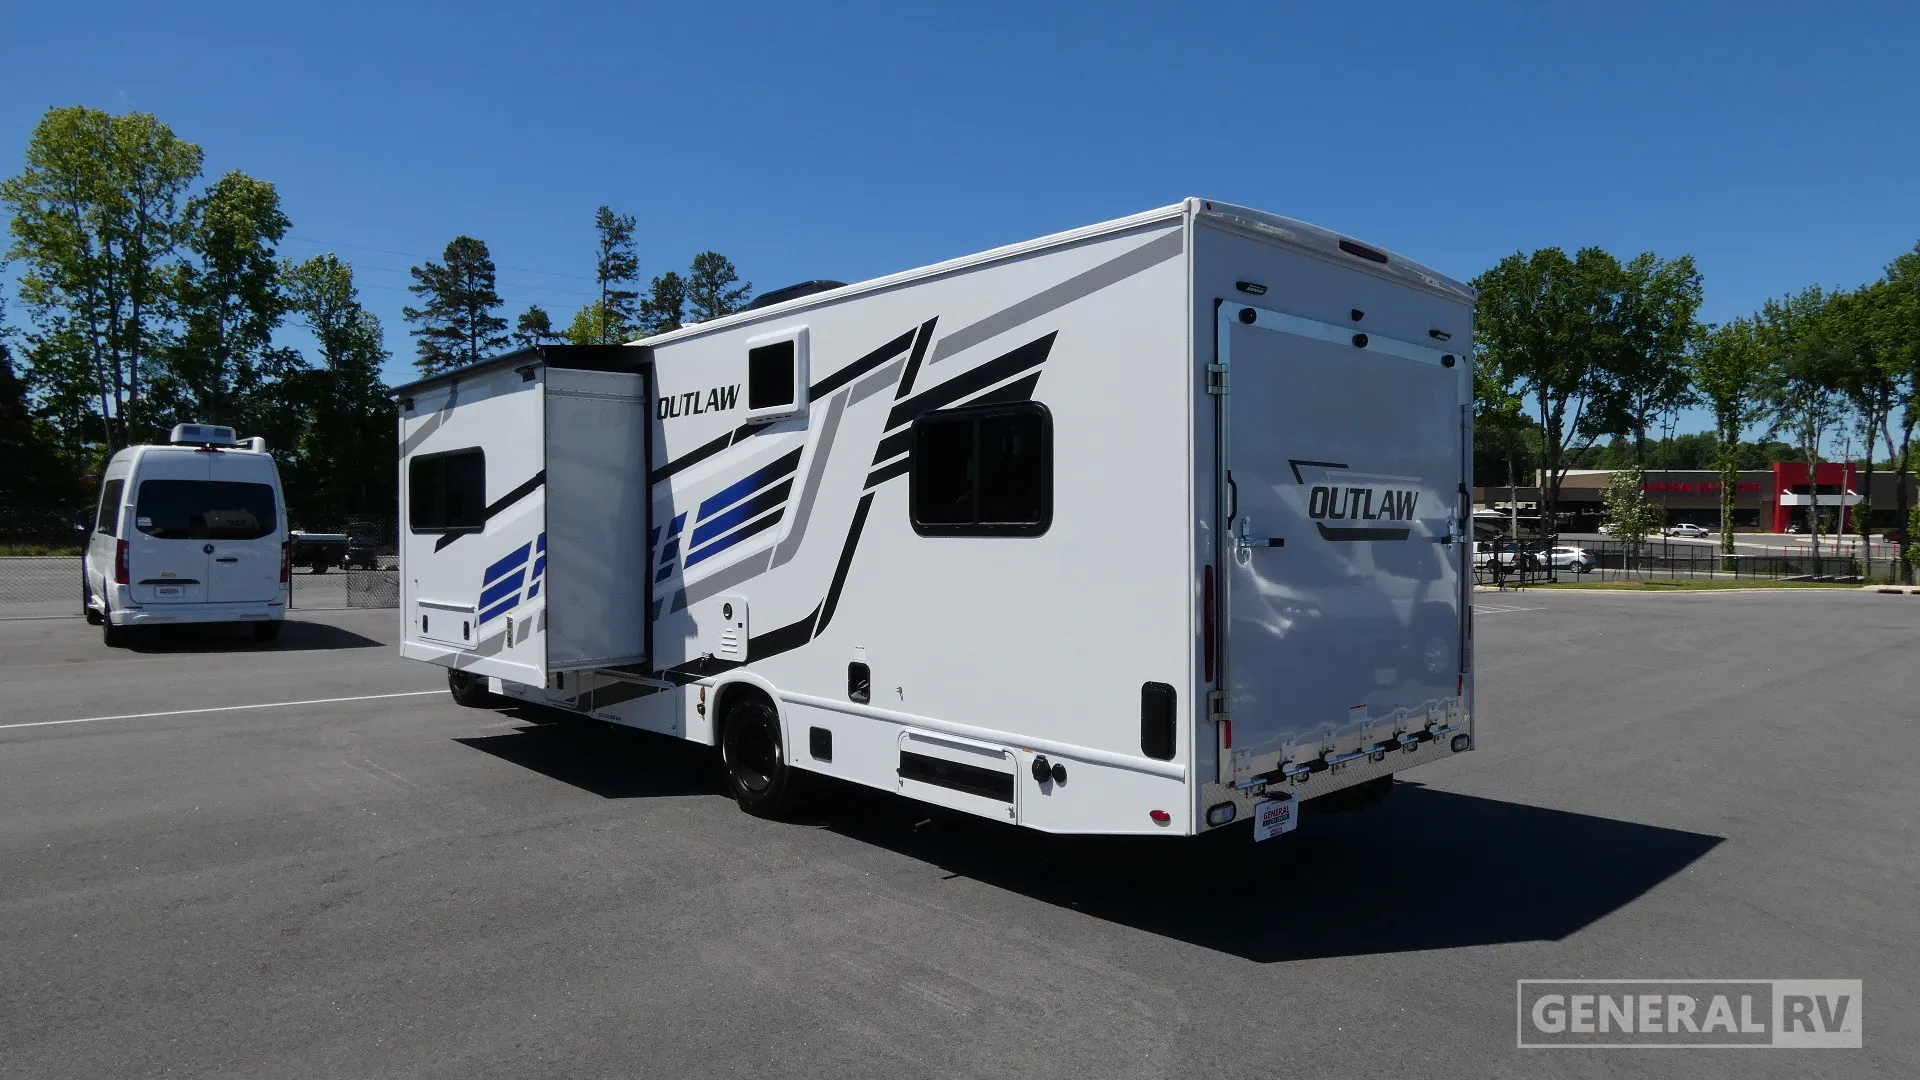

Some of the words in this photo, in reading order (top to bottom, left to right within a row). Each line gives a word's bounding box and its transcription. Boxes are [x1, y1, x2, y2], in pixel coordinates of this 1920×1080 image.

[657, 384, 741, 420] OUTLAW
[1309, 486, 1419, 521] OUTLAW
[1263, 806, 1290, 820] GENERAL
